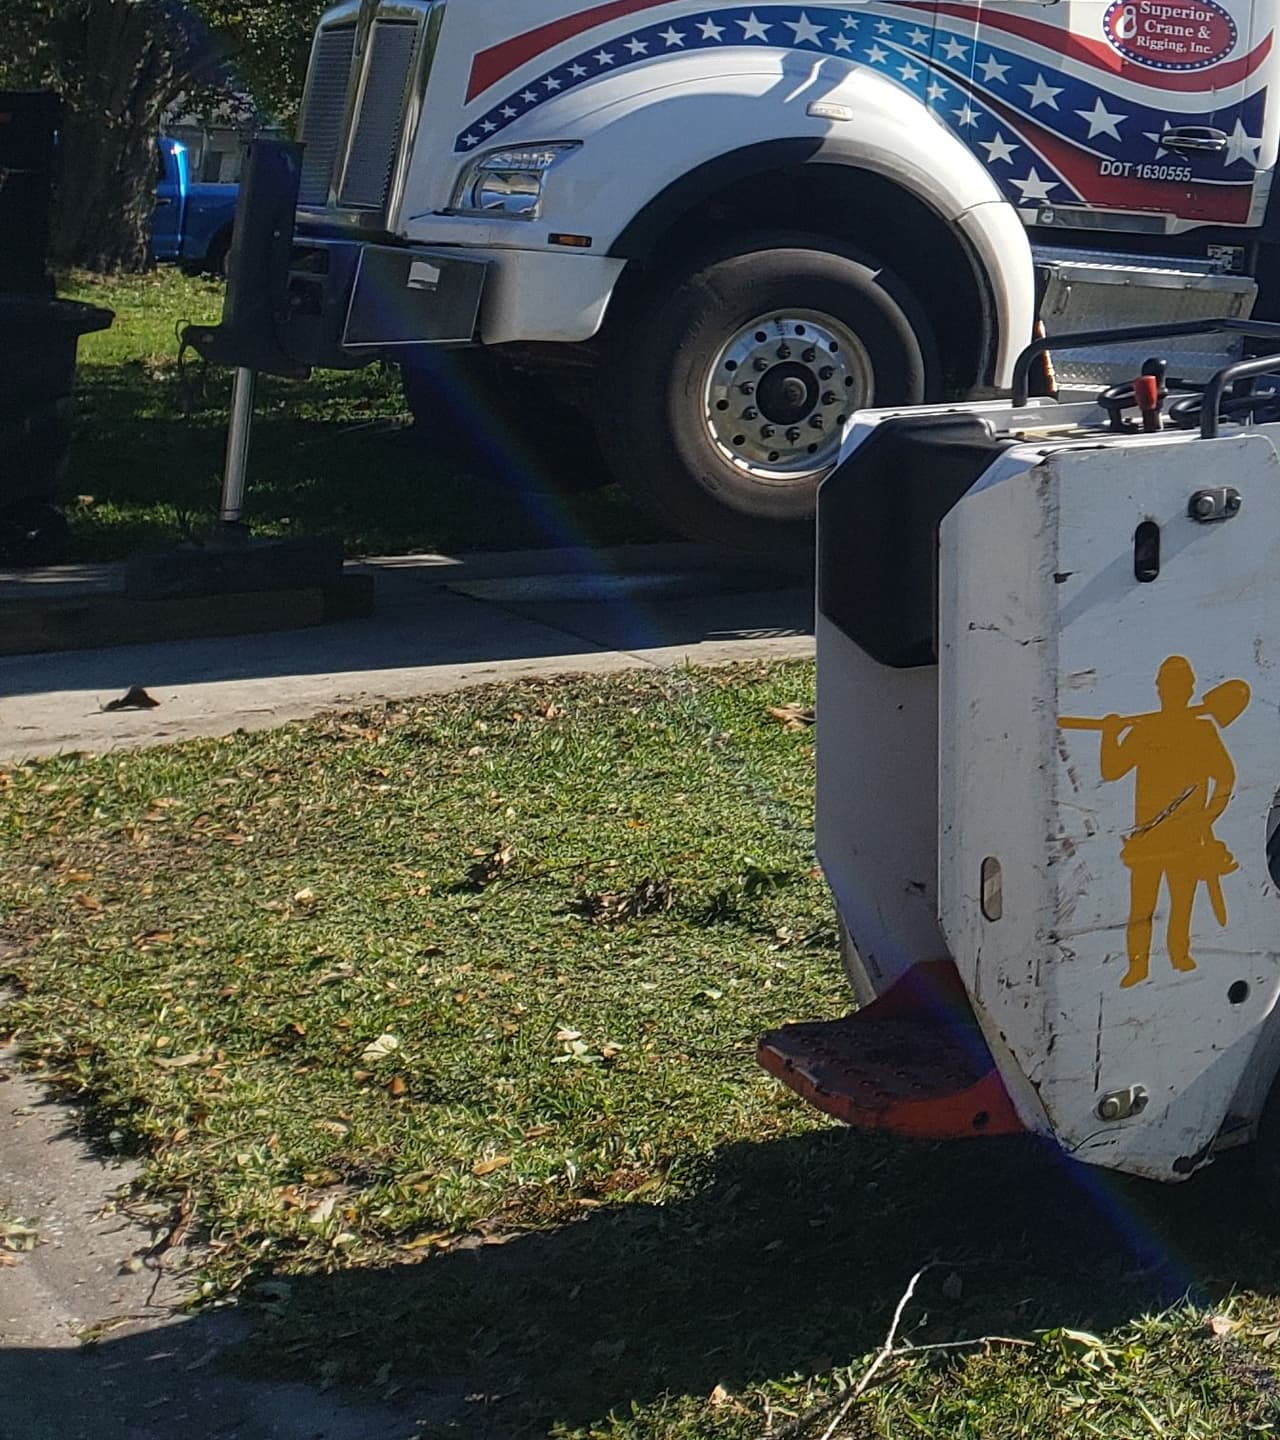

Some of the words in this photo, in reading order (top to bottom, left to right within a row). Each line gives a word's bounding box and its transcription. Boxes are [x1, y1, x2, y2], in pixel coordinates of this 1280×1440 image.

[1140, 1, 1214, 21] Superior
[1144, 19, 1194, 37] Crane
[1198, 26, 1211, 39] &
[1136, 36, 1187, 53] Rigging,
[1190, 42, 1213, 54] Inc.
[1100, 161, 1133, 177] DOT
[1135, 164, 1192, 181] 1630555
